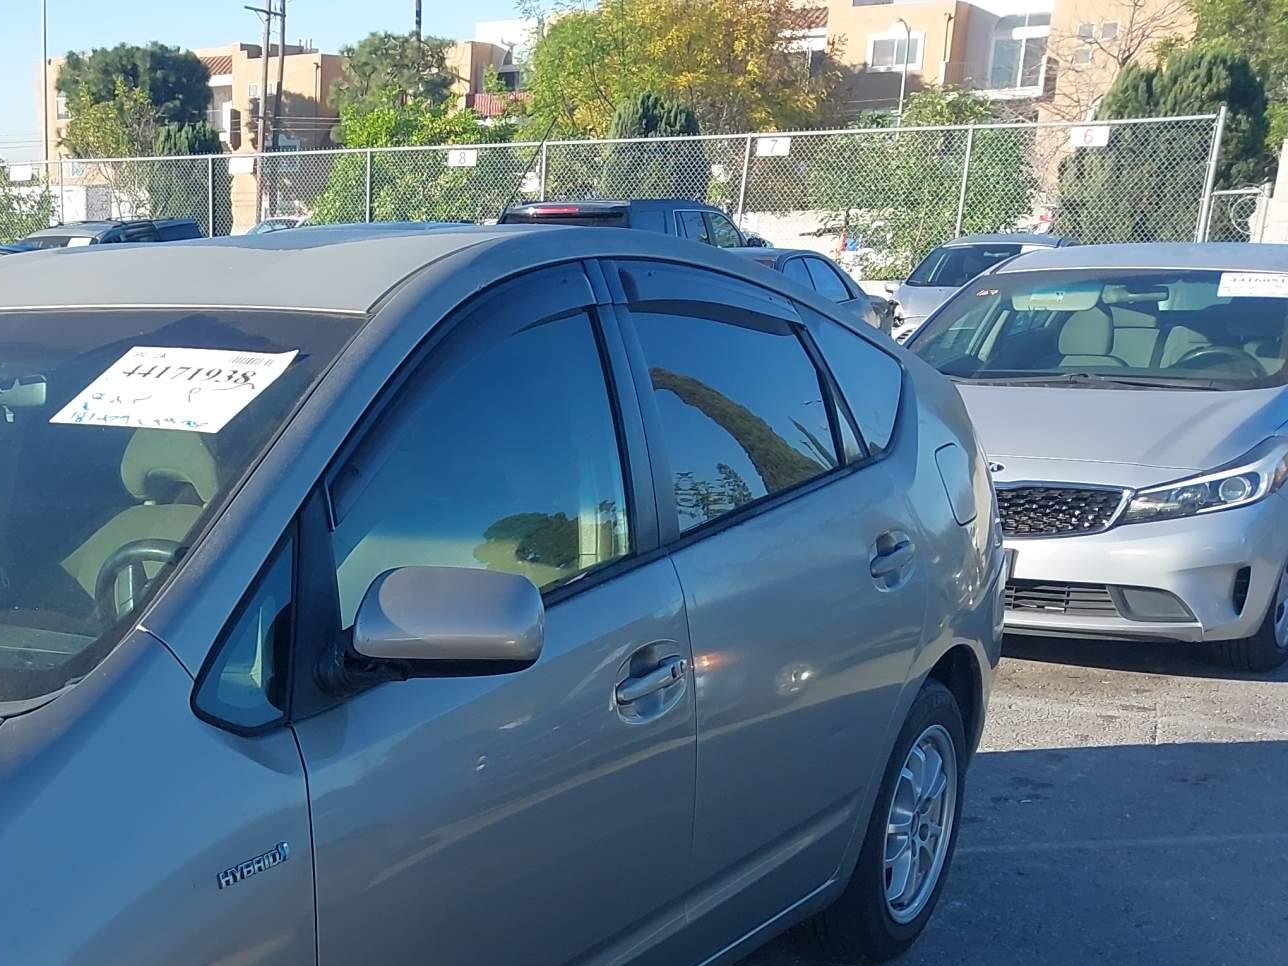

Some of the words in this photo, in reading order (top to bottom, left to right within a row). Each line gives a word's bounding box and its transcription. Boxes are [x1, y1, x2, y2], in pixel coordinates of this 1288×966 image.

[1083, 128, 1094, 145] 6
[769, 138, 779, 154] 7
[458, 151, 466, 165] 8
[122, 363, 258, 386] 44171938
[217, 849, 282, 890] HYBRID
